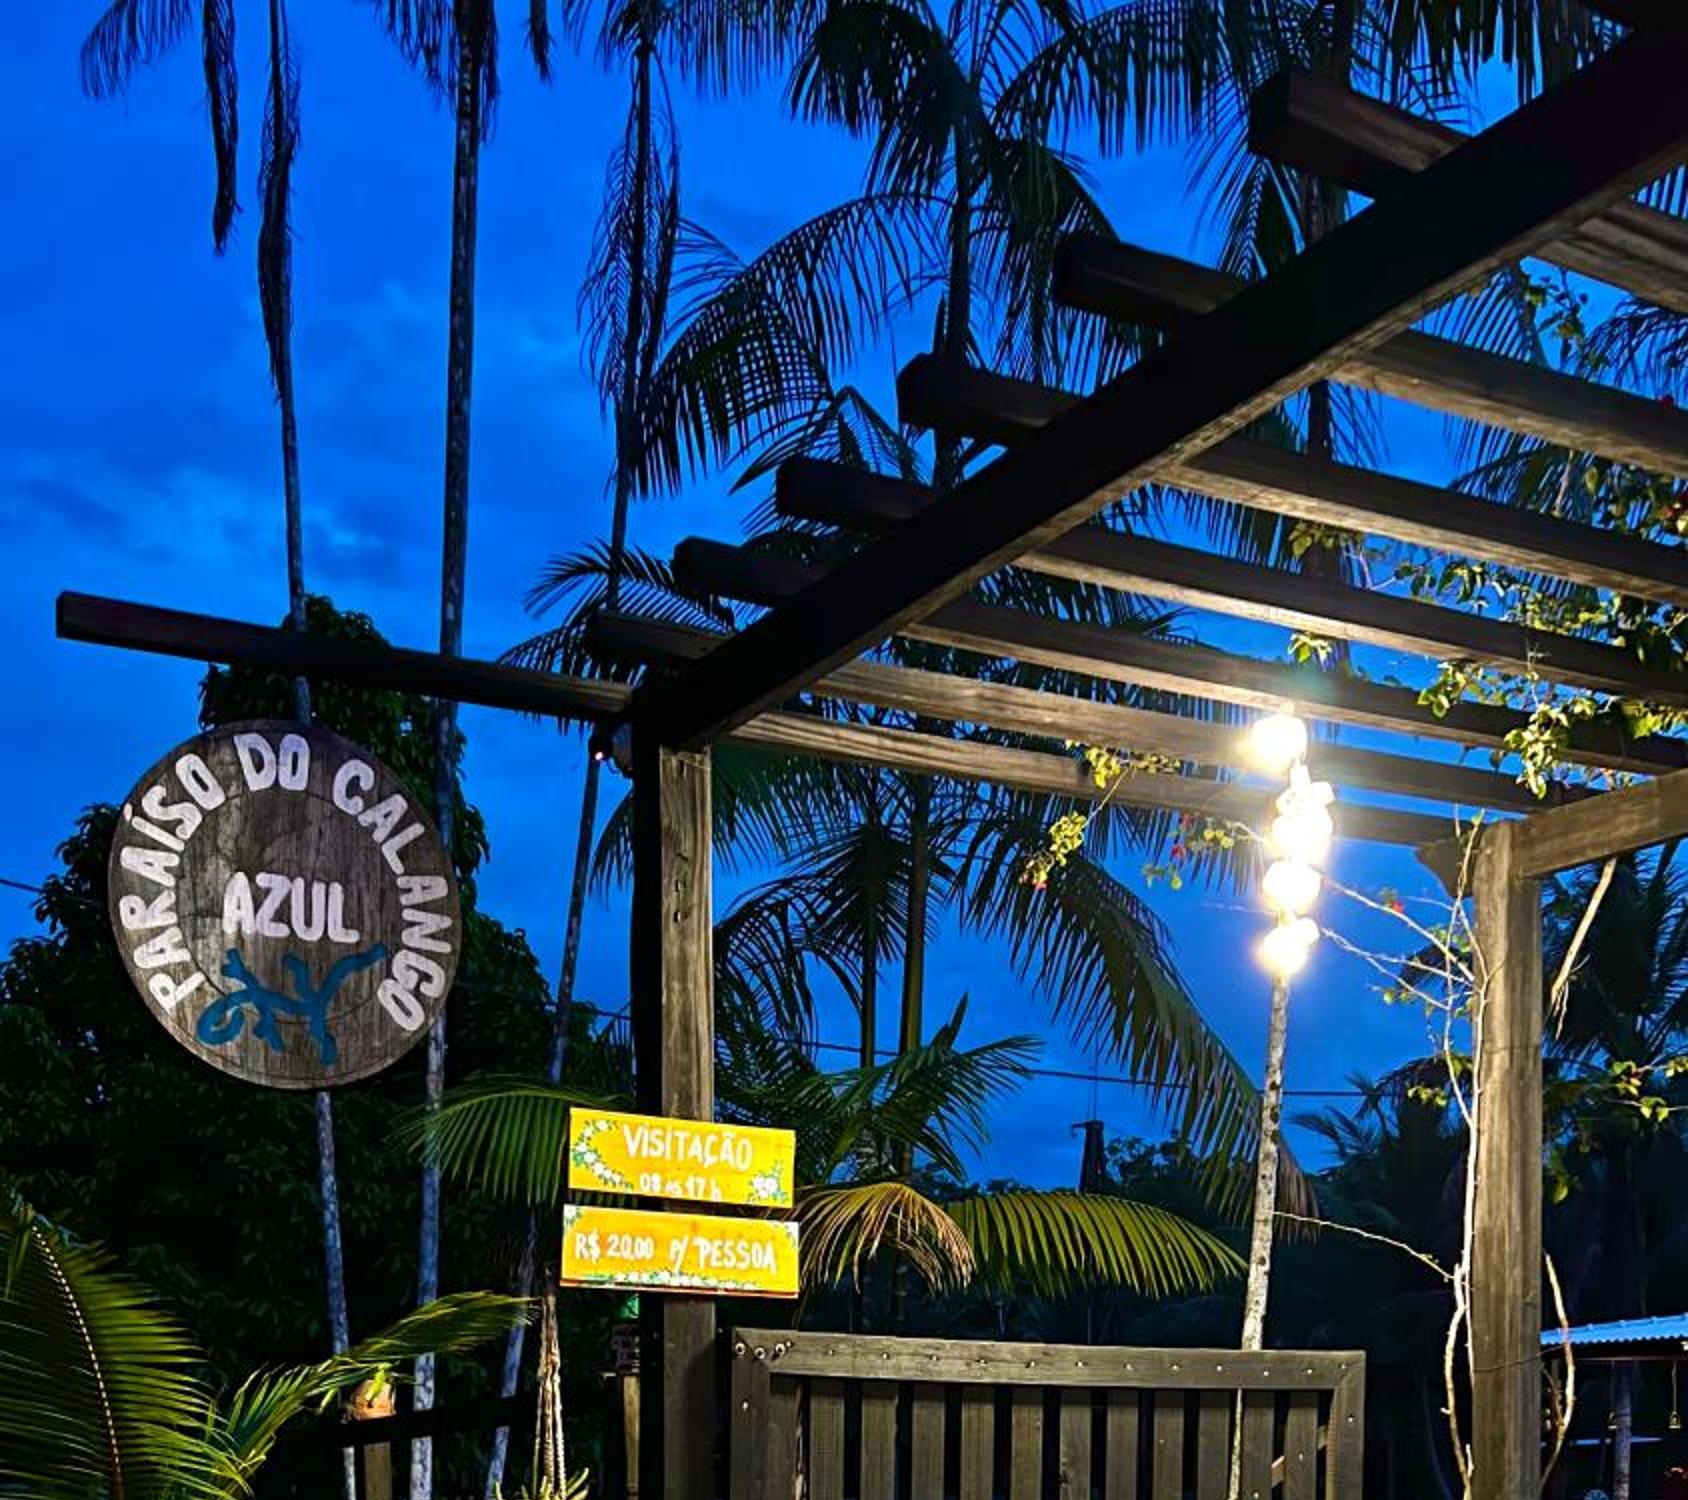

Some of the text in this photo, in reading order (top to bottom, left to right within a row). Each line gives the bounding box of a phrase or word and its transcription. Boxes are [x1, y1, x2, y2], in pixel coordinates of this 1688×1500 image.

[119, 732, 453, 1031] PARAÍSO DO CALANGO
[222, 871, 360, 943] AZUL
[623, 1124, 752, 1171] VISITAÇÃO
[639, 1173, 661, 1194] 08
[686, 1175, 705, 1200] 17
[710, 1177, 722, 1203] h
[575, 1229, 601, 1264] R$
[694, 1237, 777, 1276] PESSOA
